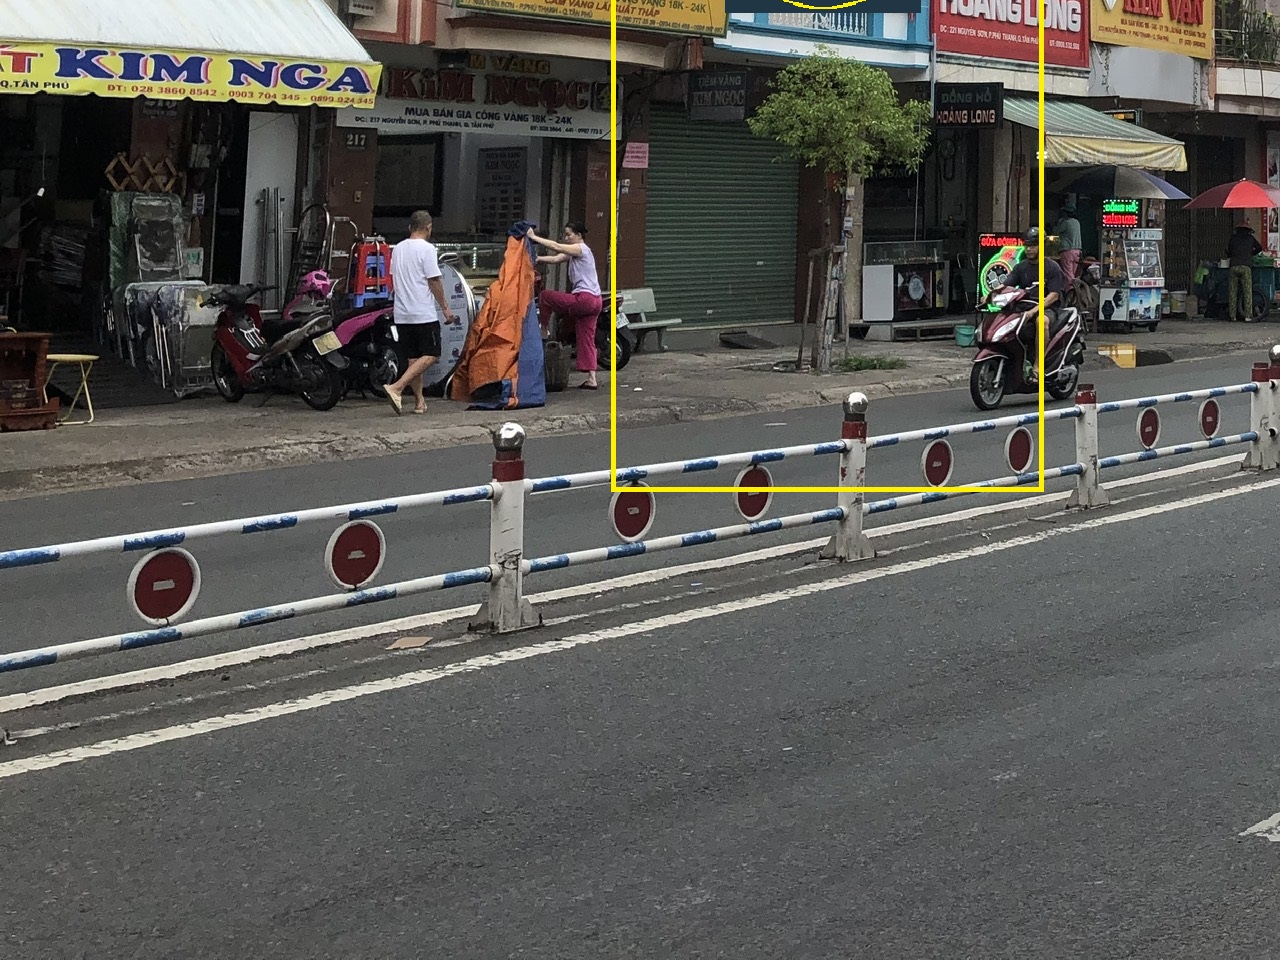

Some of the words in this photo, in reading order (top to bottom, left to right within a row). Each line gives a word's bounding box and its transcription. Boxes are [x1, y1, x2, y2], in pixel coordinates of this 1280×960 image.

[668, 0, 684, 11] 18K
[690, 3, 707, 14] 24K
[0, 41, 43, 75] T
[54, 46, 214, 85] KIM
[227, 57, 375, 95] NGA
[493, 53, 551, 75] VÀNG
[43, 79, 70, 91] PHÚ
[484, 72, 590, 115] NGỌC
[130, 85, 155, 94] 028
[156, 86, 187, 96] 3860
[188, 88, 218, 97] 8542
[228, 89, 256, 99] 0903
[256, 91, 279, 100] 704
[279, 93, 301, 102] 345
[355, 96, 374, 106] 345
[941, 89, 973, 104] ĐỒNG
[976, 88, 992, 104] HỒ
[404, 106, 430, 118] MUA
[432, 106, 454, 118] BÁN
[456, 110, 473, 120] GIA
[475, 109, 501, 121] CÔNG
[503, 110, 529, 122] VÀNG
[532, 114, 547, 124] 18K
[554, 115, 573, 125] 24K
[936, 106, 968, 124] HOÀNG
[971, 109, 997, 124] LONG
